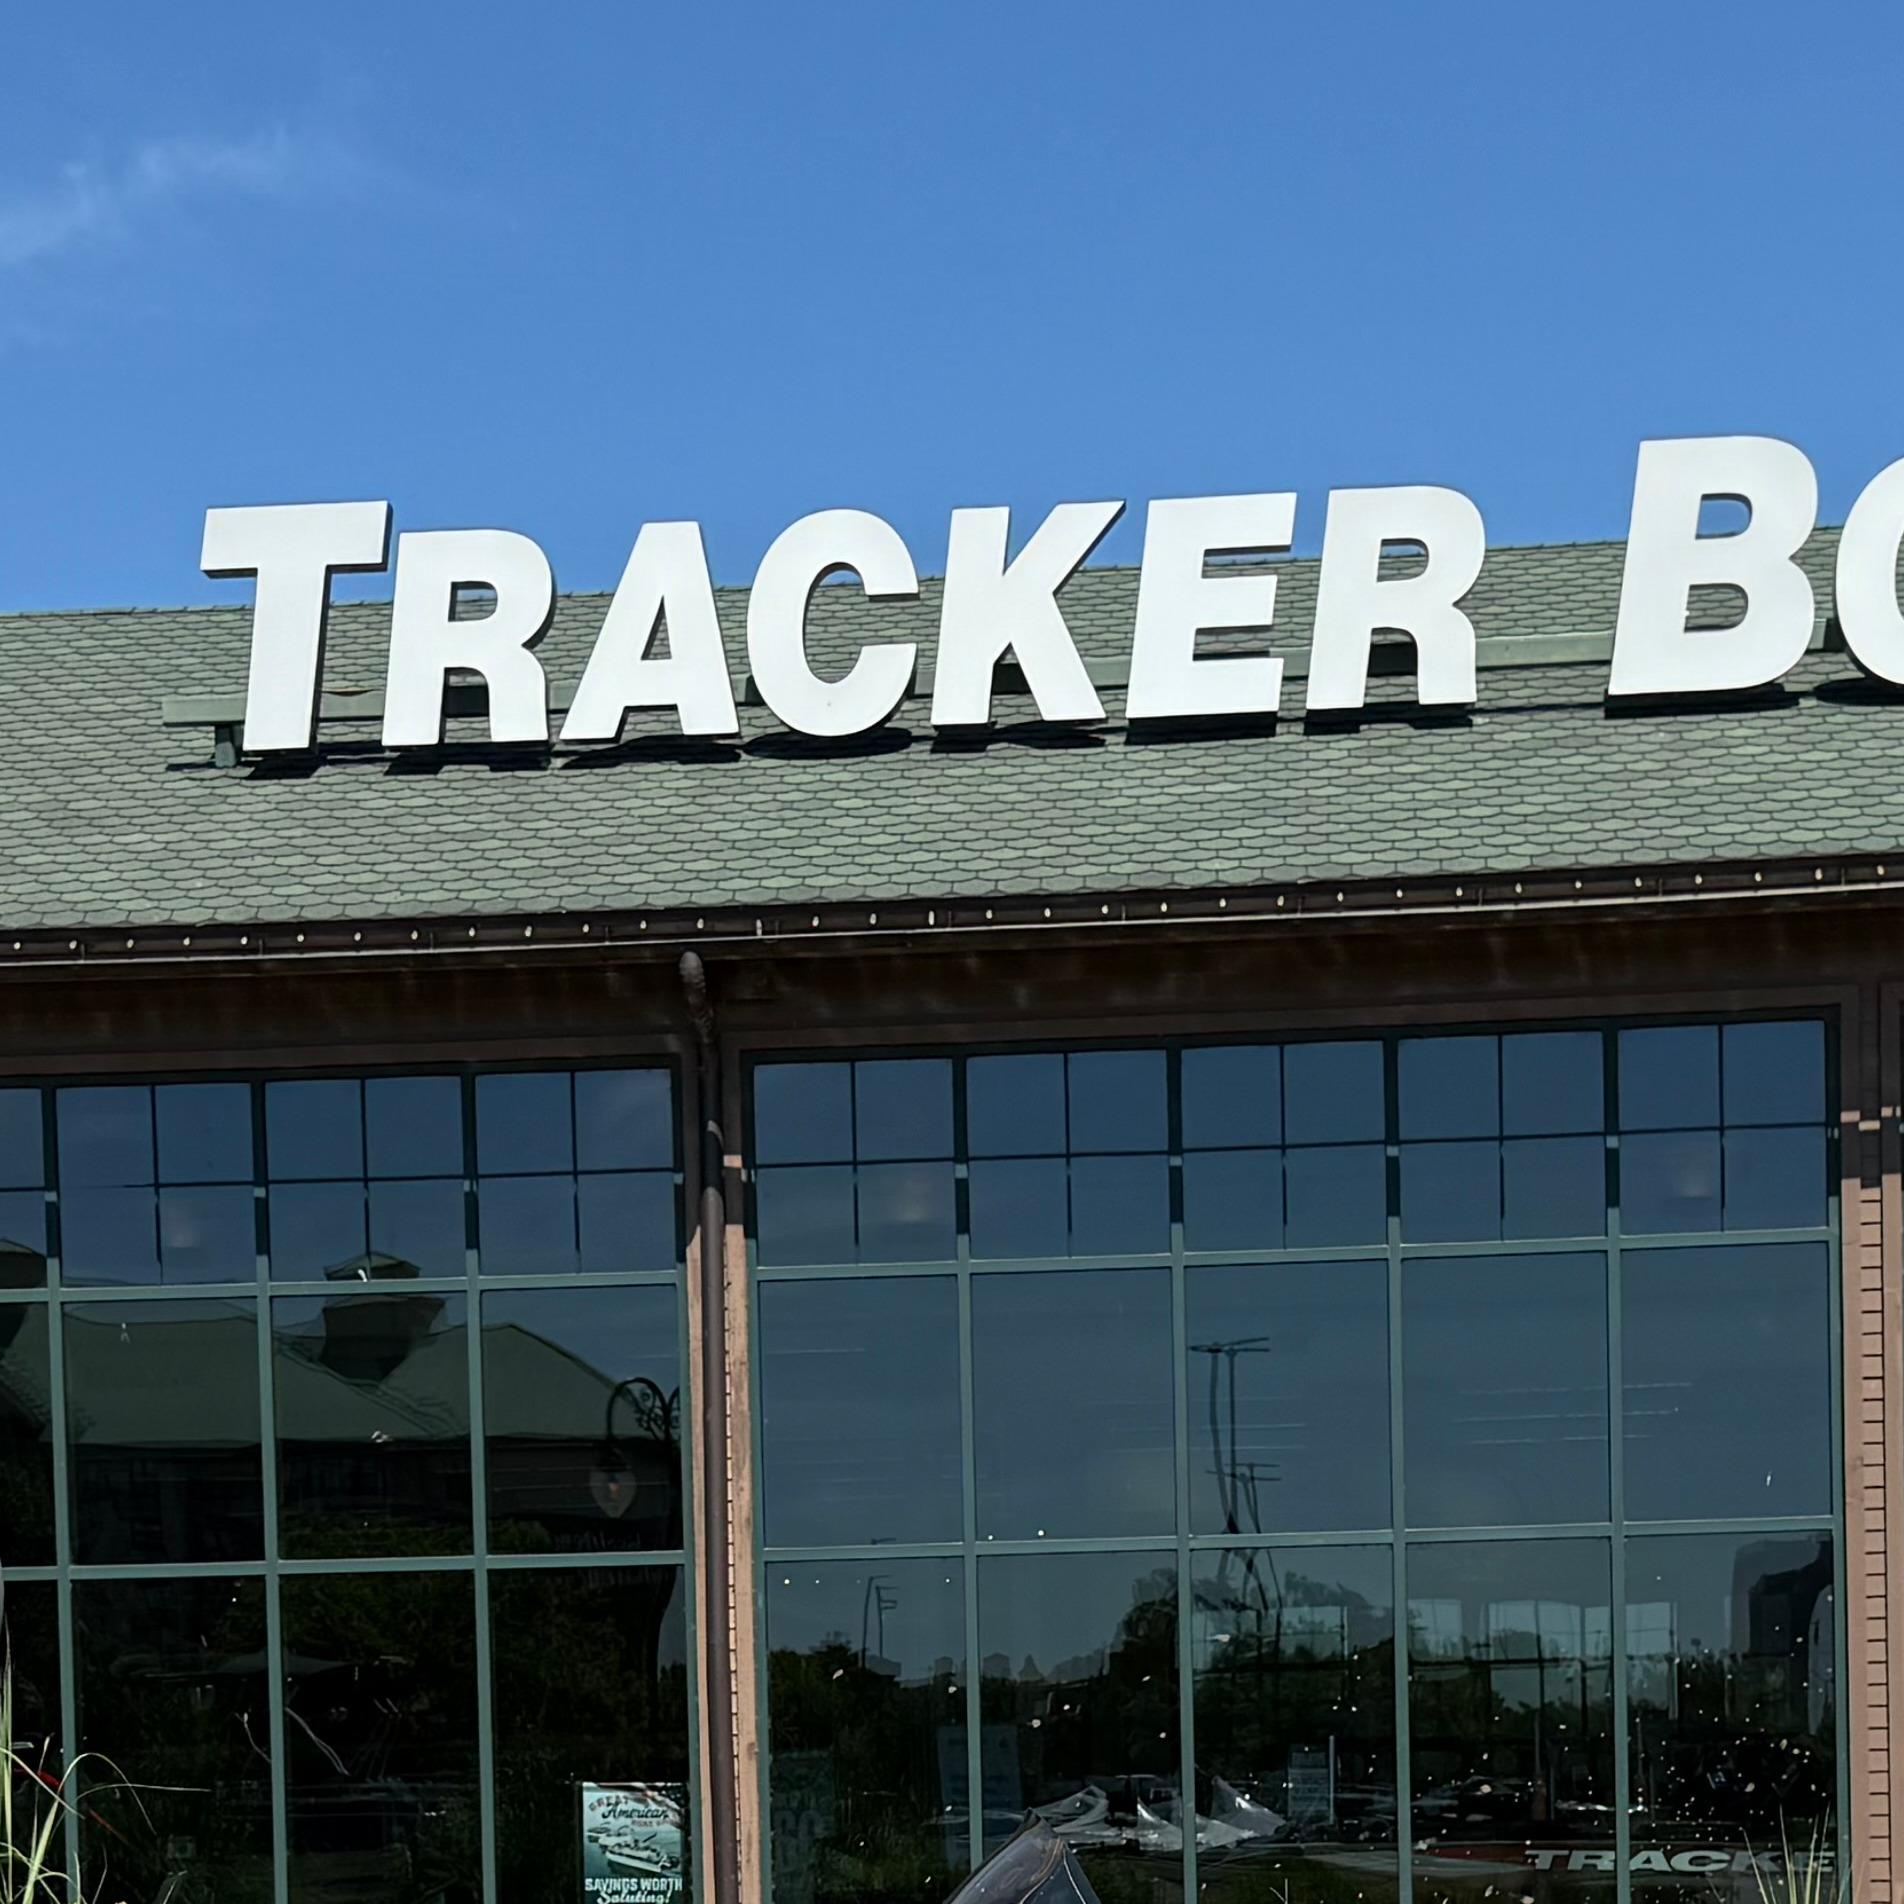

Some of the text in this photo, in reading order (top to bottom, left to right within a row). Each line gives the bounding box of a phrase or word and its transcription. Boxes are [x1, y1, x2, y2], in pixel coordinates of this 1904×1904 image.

[200, 485, 1486, 755] TRACKER
[585, 1877, 683, 1892] SAVINGS WORTH
